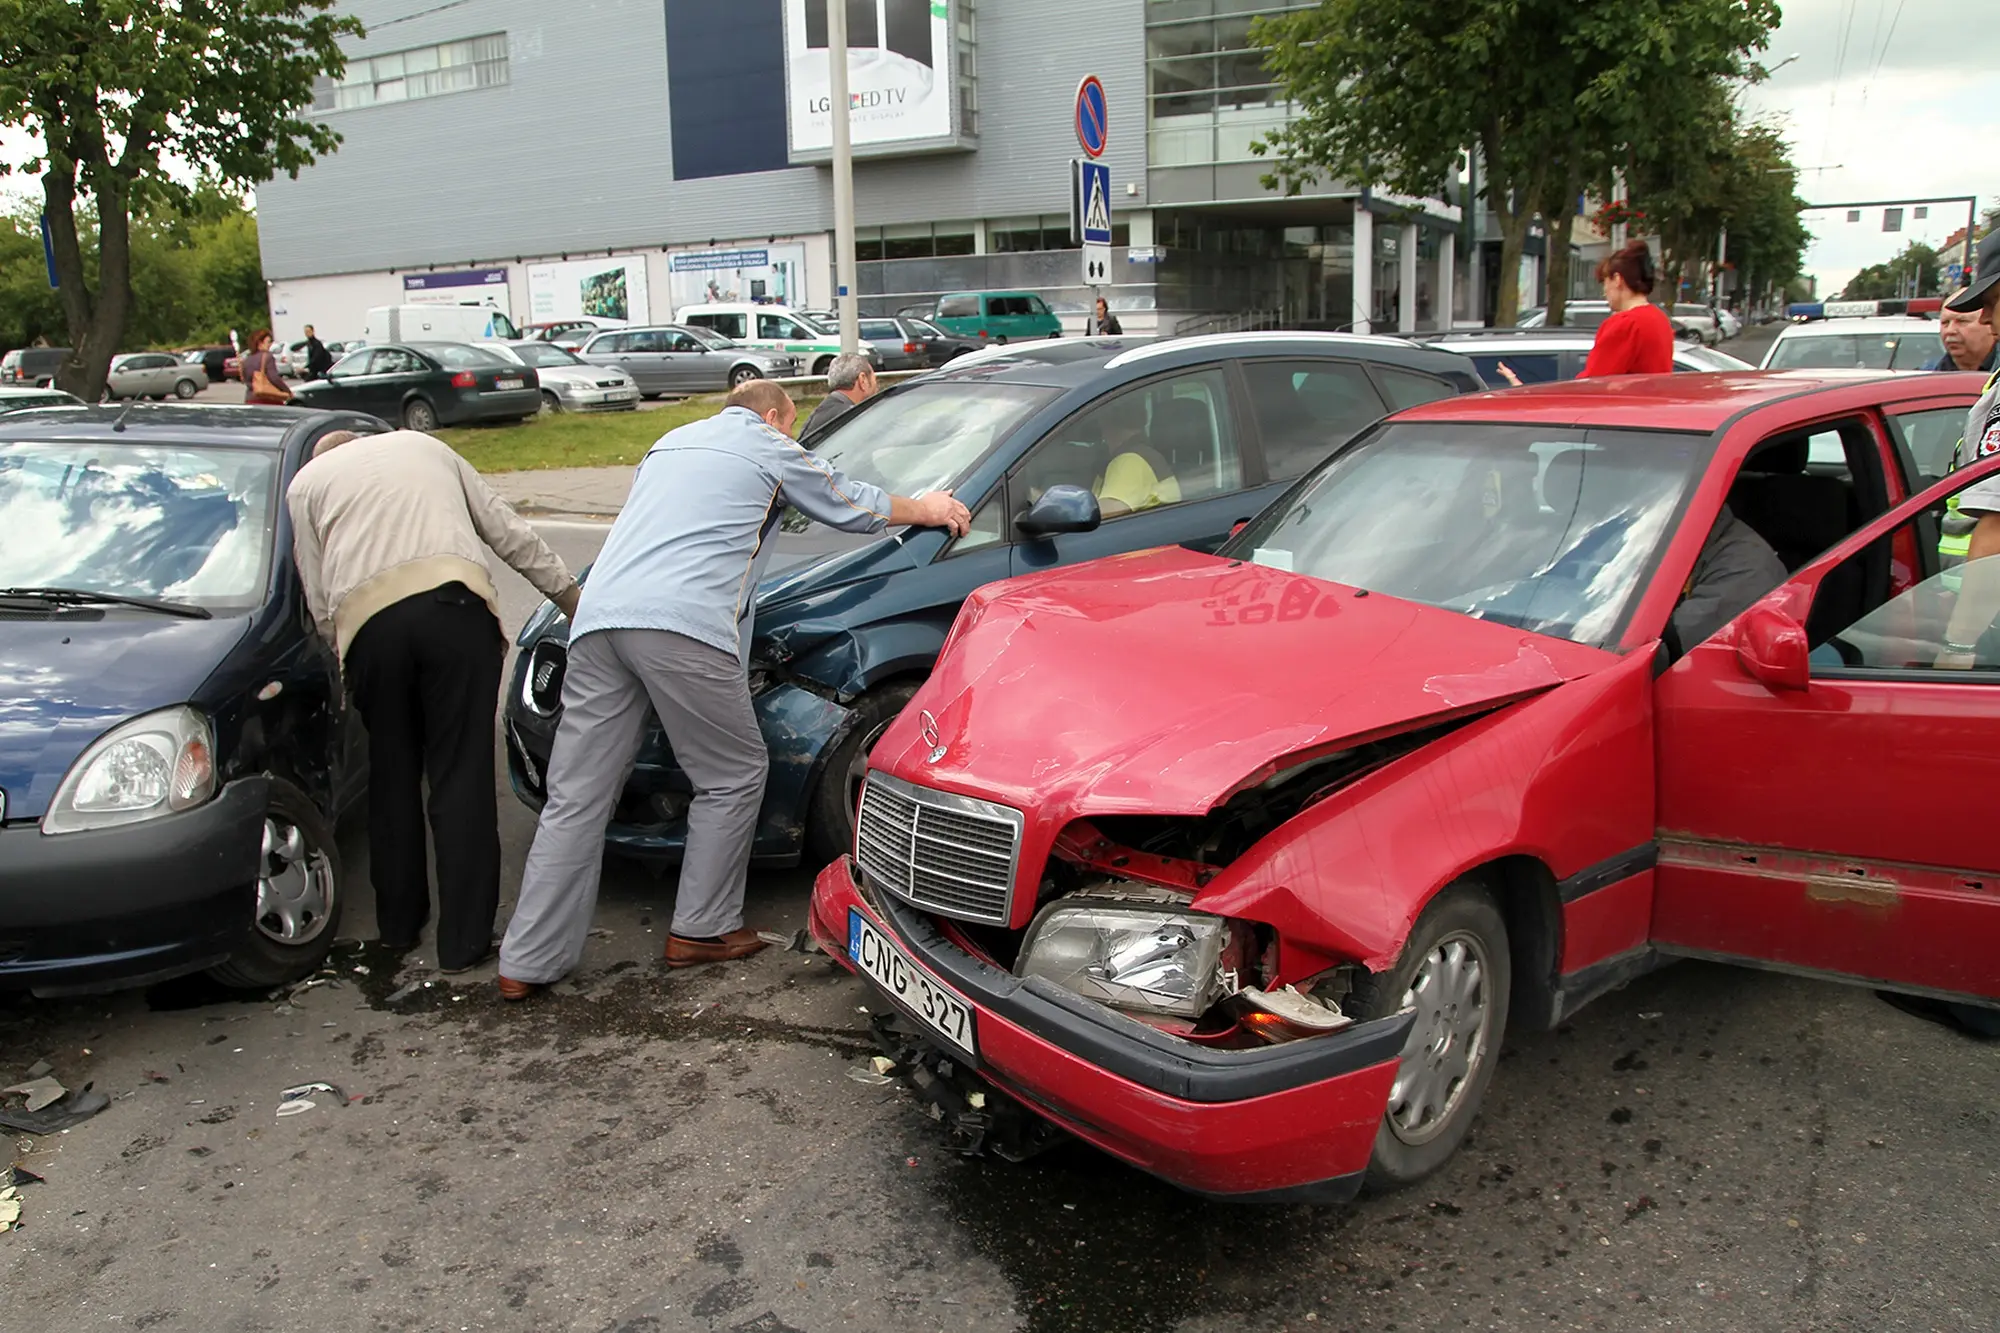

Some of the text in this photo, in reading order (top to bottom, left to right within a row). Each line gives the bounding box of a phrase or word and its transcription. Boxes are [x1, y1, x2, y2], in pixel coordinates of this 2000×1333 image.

[809, 97, 830, 113] LG
[884, 88, 906, 105] TV
[1826, 303, 1876, 316] POLICIJA
[851, 939, 860, 954] LT
[862, 928, 966, 1041] CNG 327
